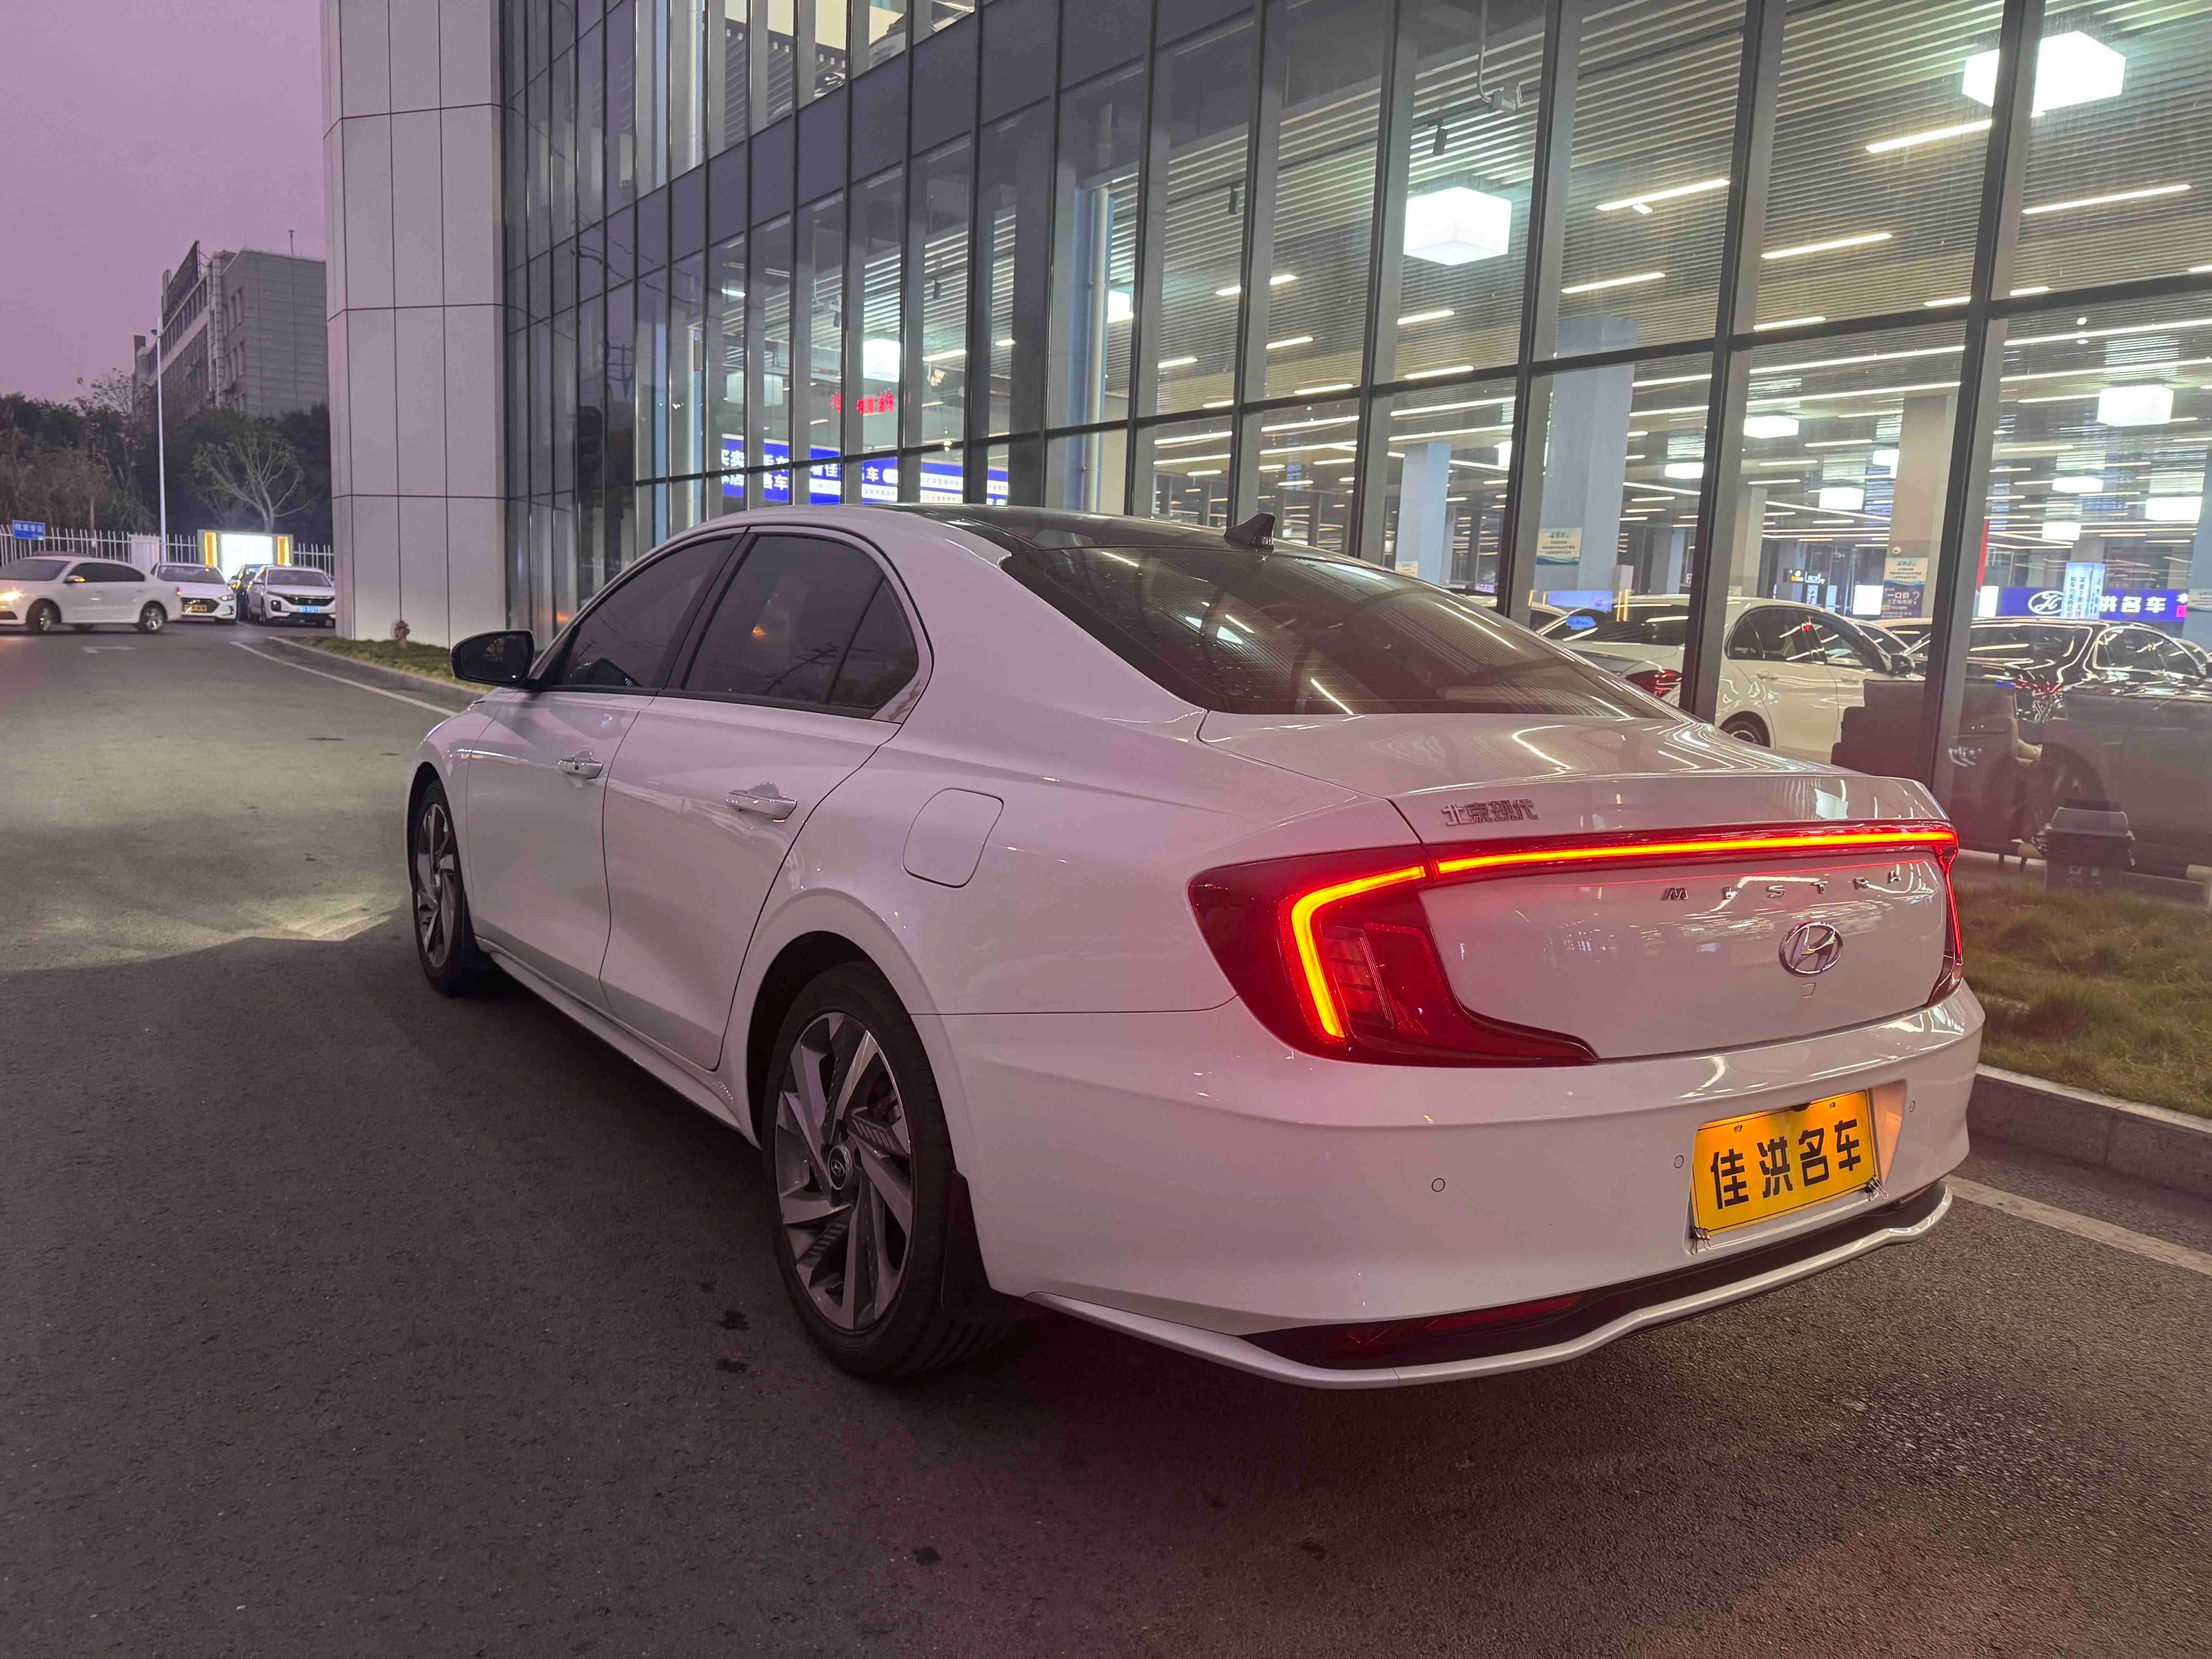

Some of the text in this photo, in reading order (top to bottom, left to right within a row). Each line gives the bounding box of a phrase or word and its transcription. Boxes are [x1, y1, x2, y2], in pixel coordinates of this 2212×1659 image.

[1441, 799, 1538, 826] 北京现代
[1710, 1119, 1861, 1209] 佳洪名车
